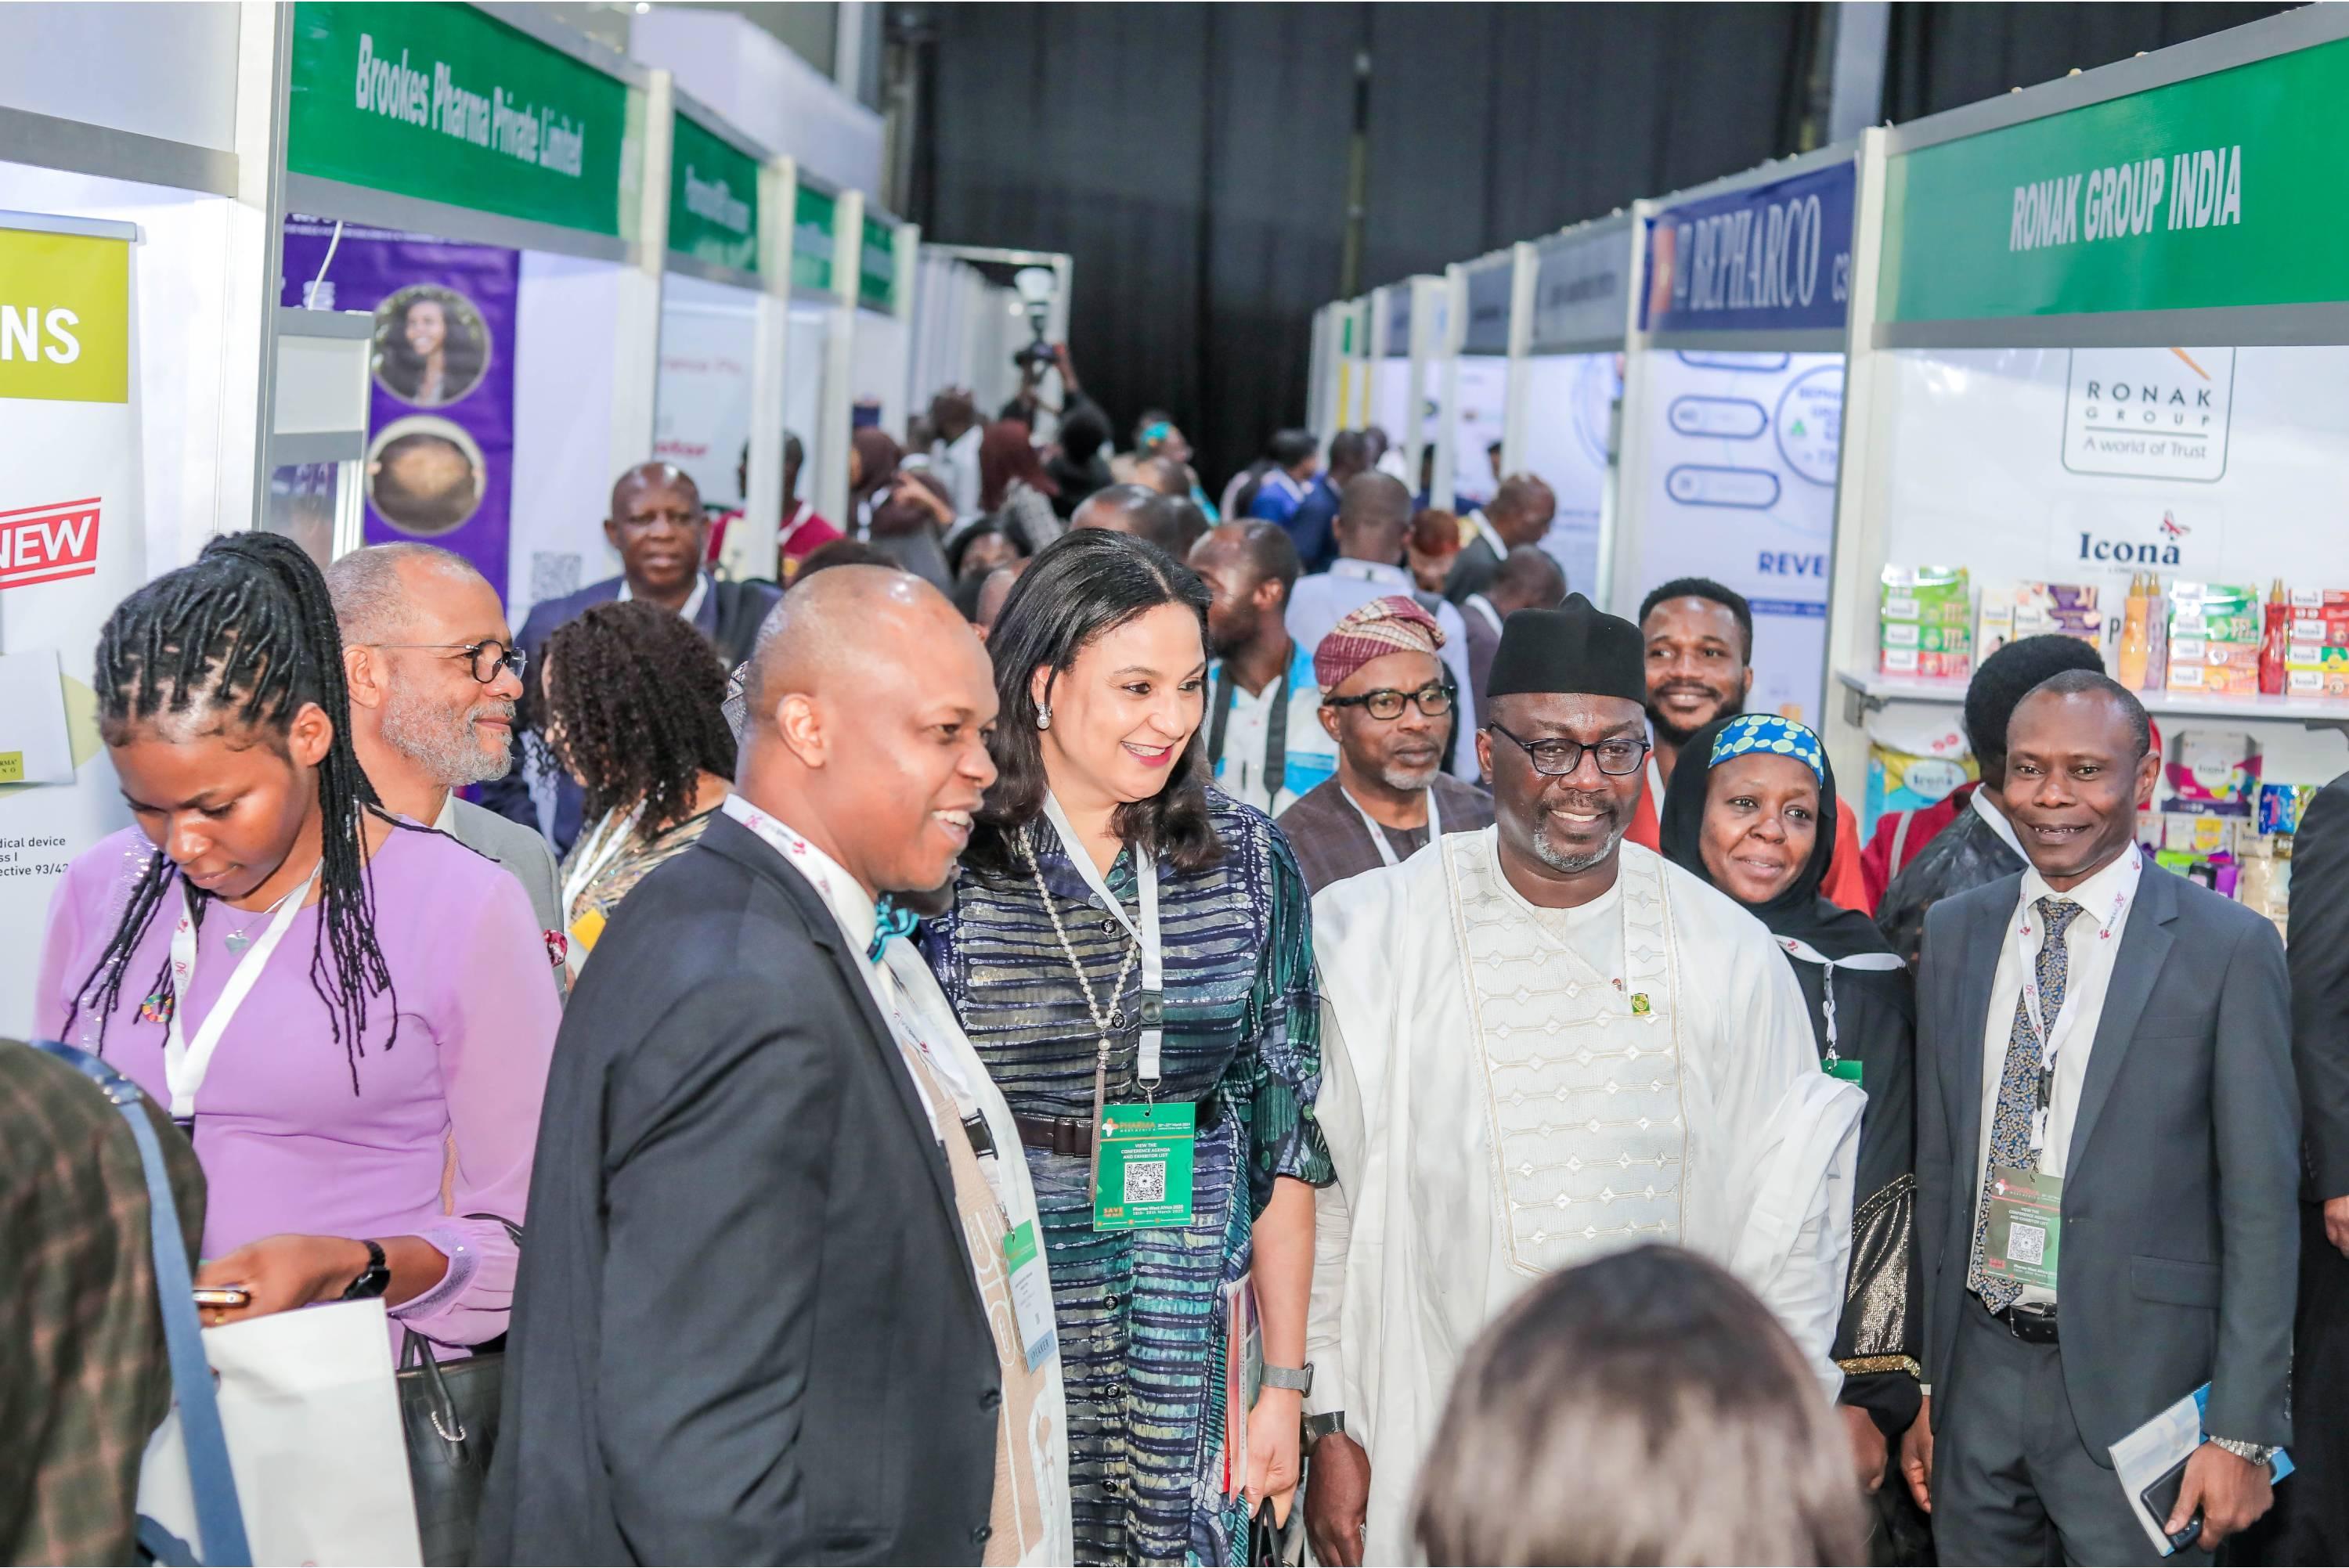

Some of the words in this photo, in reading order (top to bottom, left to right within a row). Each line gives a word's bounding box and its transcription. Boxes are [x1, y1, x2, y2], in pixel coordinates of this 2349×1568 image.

[355, 33, 429, 127] Brookes
[432, 61, 490, 147] Pharma
[492, 86, 539, 164] Private
[539, 106, 584, 178] Limited
[2009, 174, 2083, 252] RONAK
[2084, 158, 2165, 242] GROUP
[2167, 145, 2241, 231] INDIA
[1, 305, 80, 364] NS
[2087, 380, 2211, 408] RONAK
[2085, 406, 2210, 427] GROUP
[2084, 436, 2097, 451] A
[2101, 440, 2145, 455] world
[2149, 442, 2167, 456] of
[2171, 442, 2207, 459] Trust
[28, 836, 66, 847] device
